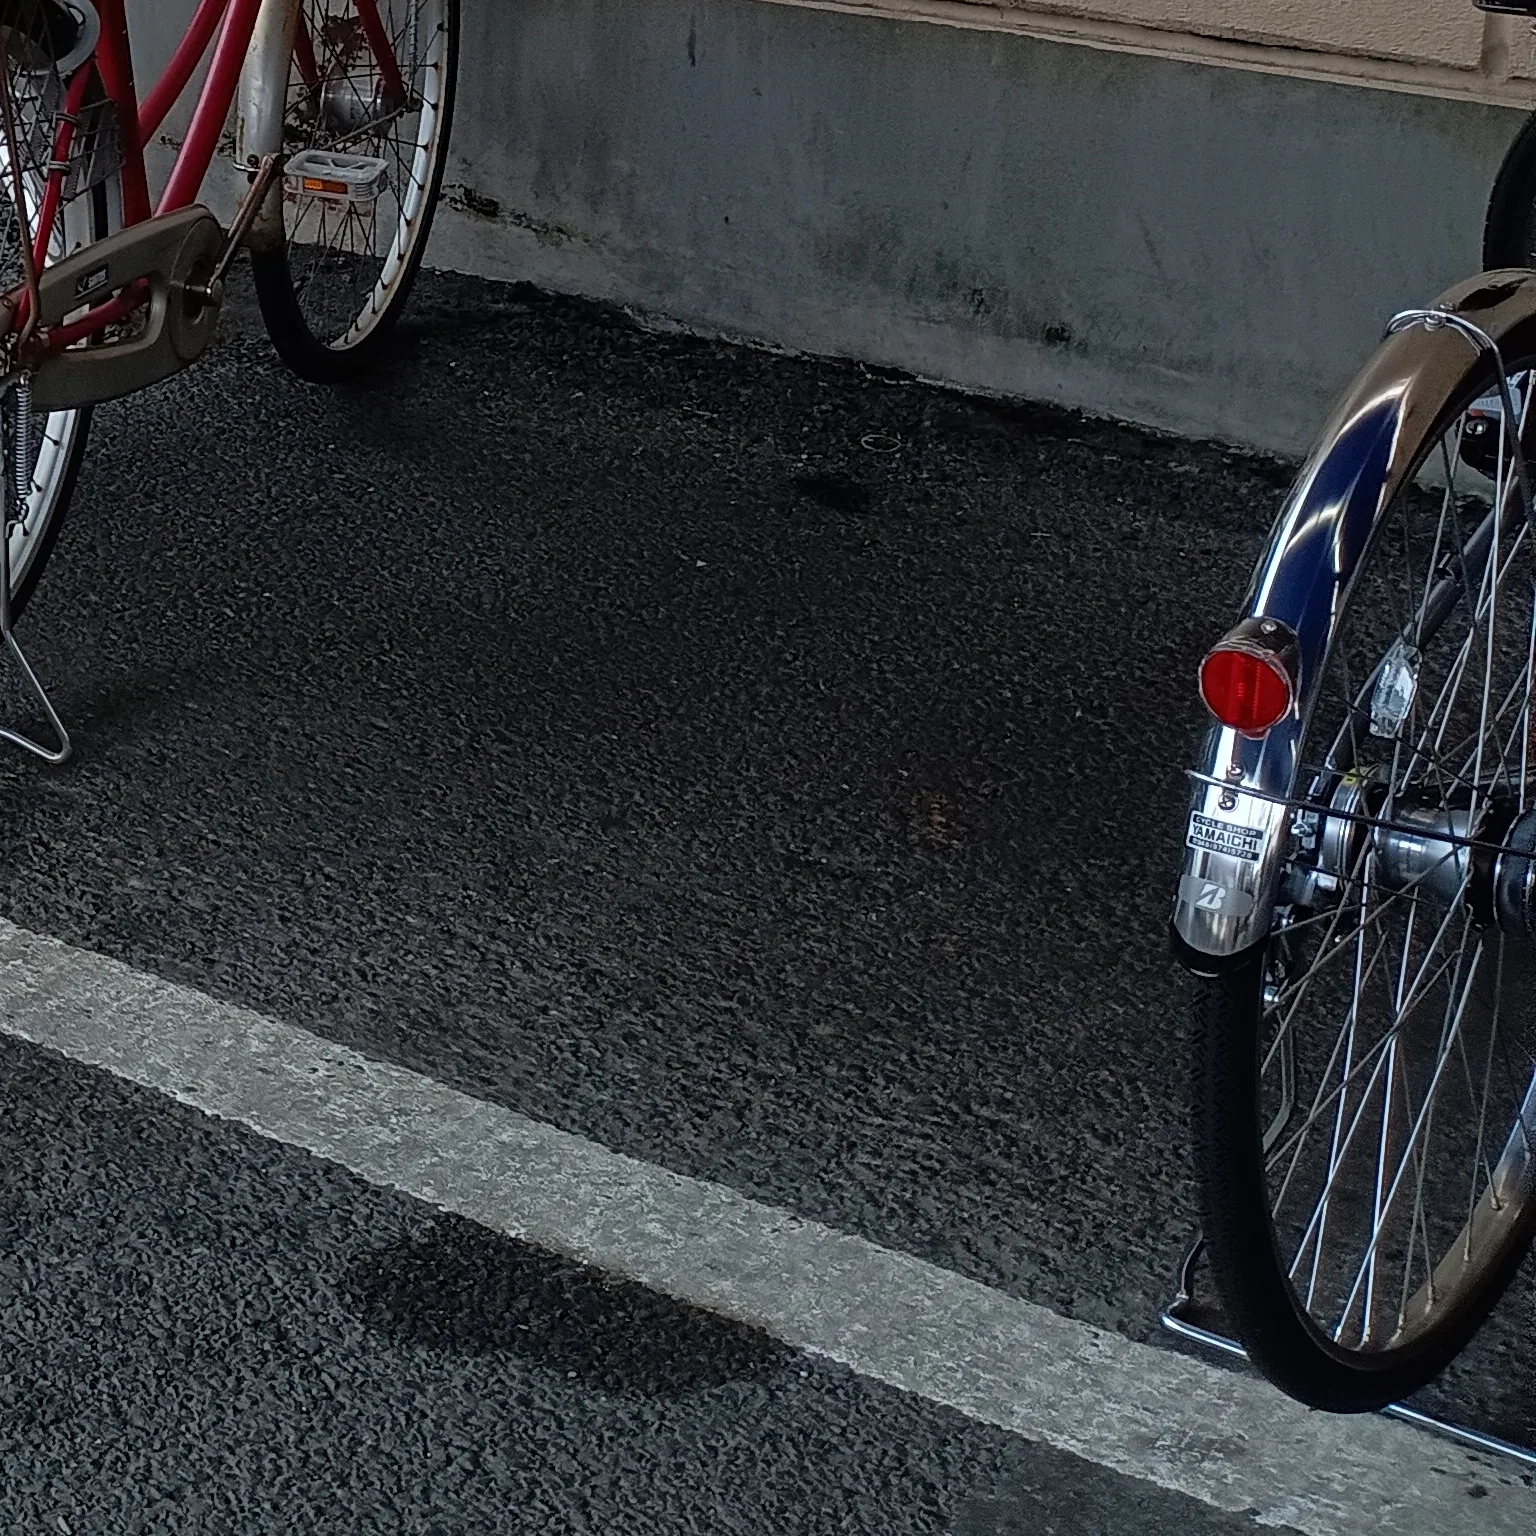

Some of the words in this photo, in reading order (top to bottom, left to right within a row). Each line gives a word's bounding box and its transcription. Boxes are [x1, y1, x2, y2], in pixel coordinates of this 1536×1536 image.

[1192, 824, 1258, 851] YAMAICHI
[1195, 816, 1224, 829] CYCLE
[1226, 823, 1257, 836] SHOP
